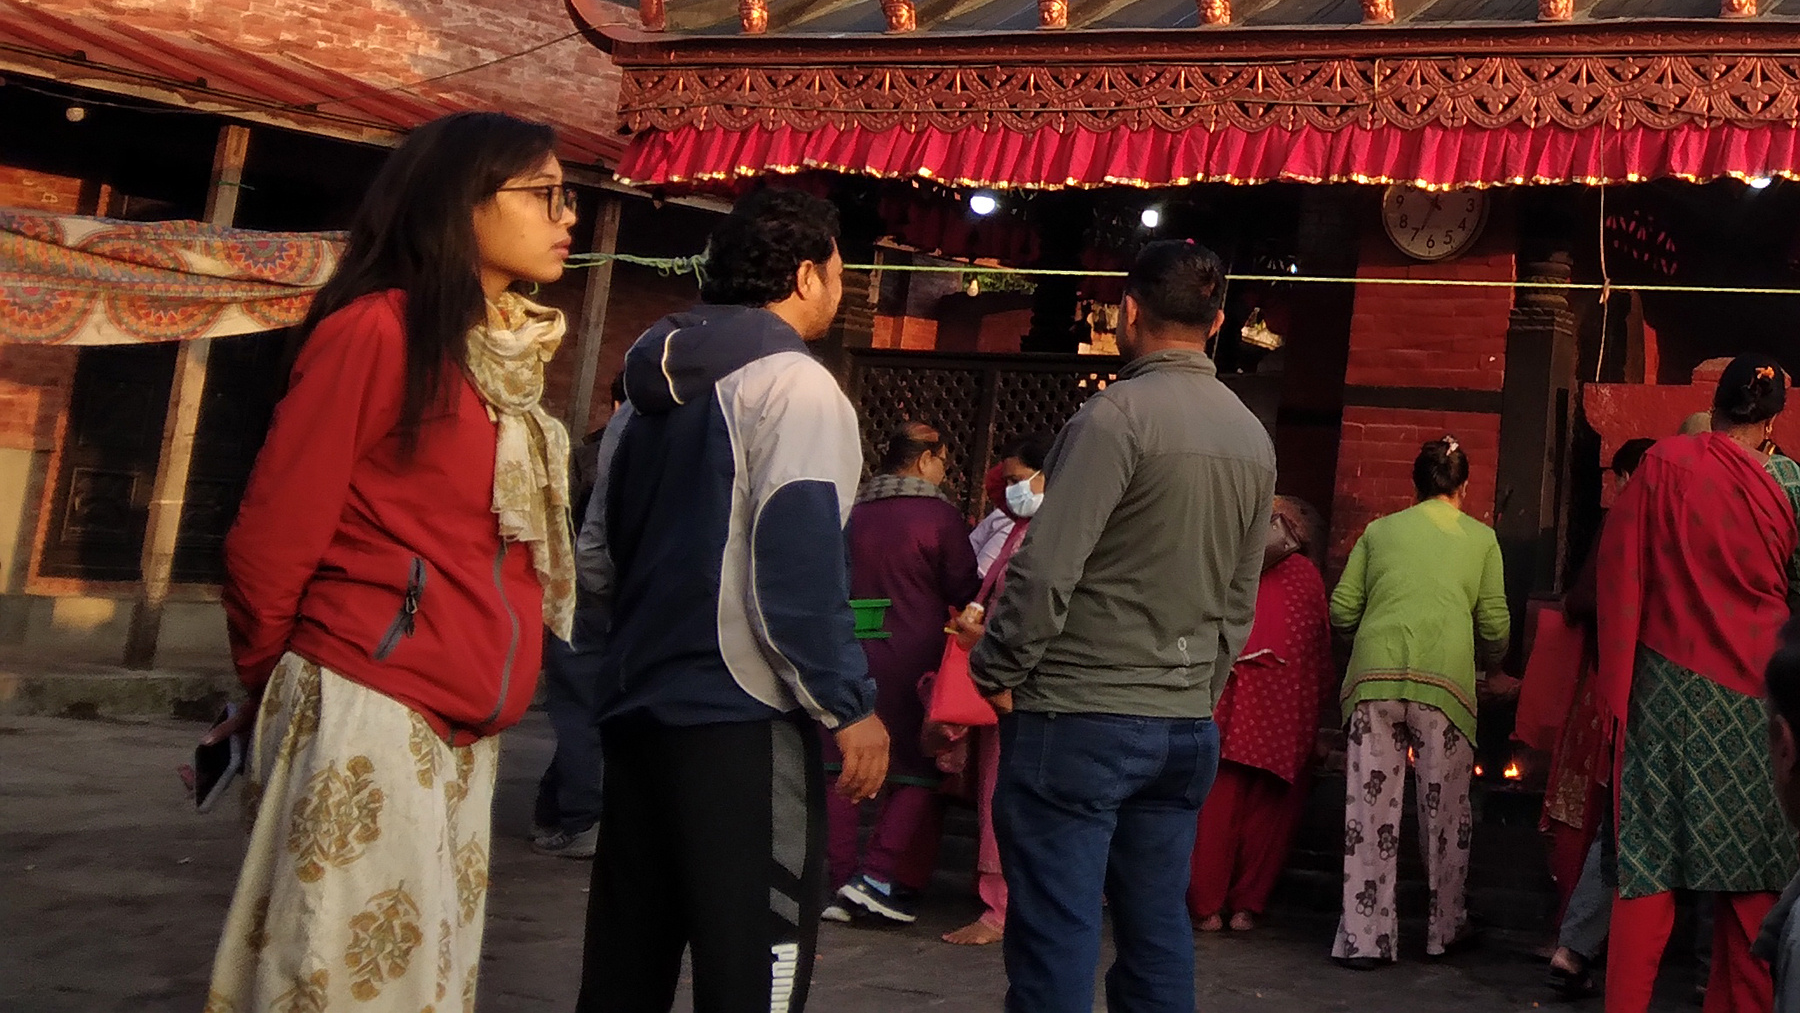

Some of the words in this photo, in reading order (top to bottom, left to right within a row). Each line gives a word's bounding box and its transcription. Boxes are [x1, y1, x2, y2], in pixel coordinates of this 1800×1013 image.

[1395, 195, 1405, 209] 9
[1466, 198, 1475, 212] 3
[1399, 214, 1408, 228] 8
[1458, 217, 1466, 231] 4
[1411, 227, 1420, 241] 7
[1426, 234, 1435, 248] 6
[1443, 230, 1453, 245] 5
